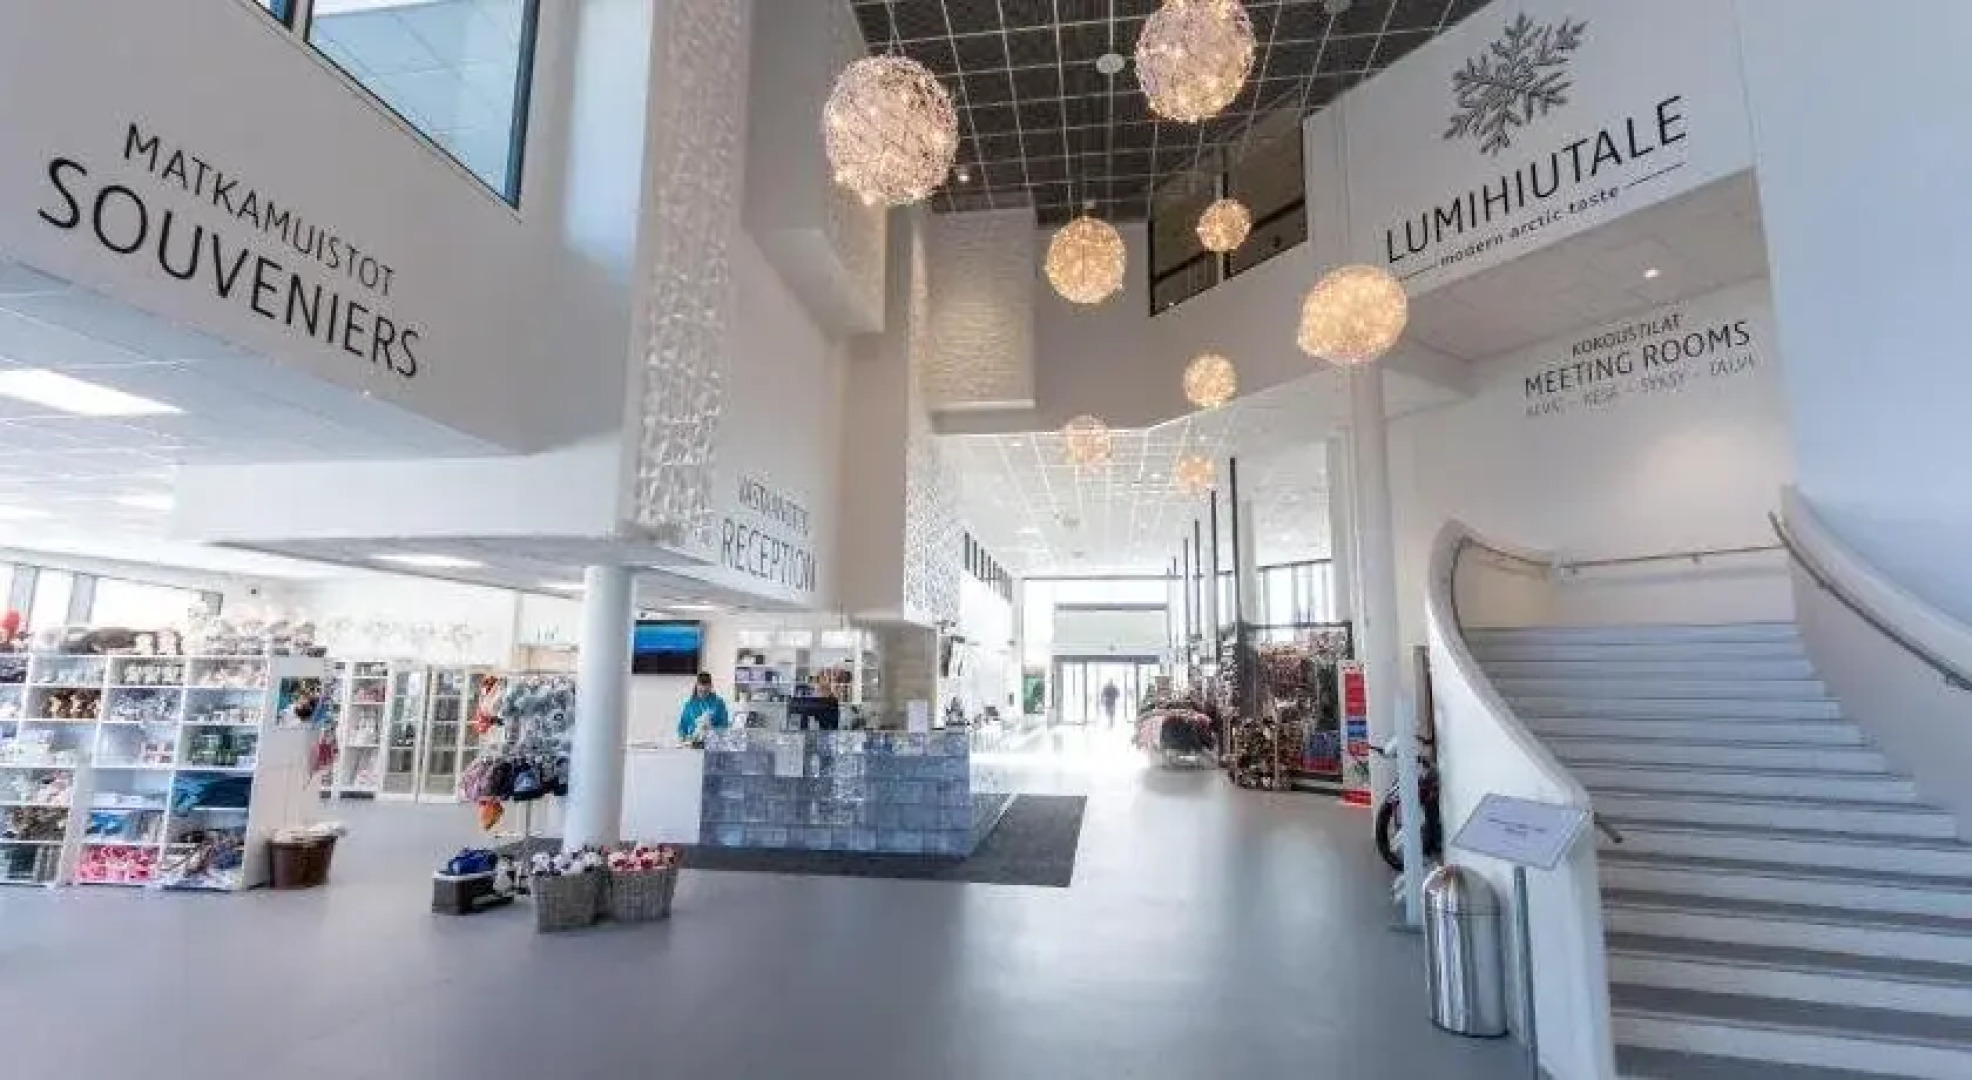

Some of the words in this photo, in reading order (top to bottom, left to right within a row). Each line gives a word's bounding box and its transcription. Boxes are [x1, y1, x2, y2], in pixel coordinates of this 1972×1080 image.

[123, 120, 395, 297] MATKAMUISTOT
[1386, 94, 1688, 264] LUMIHIUTALE
[1440, 233, 1504, 267] modern
[1509, 208, 1563, 239] arctic
[1568, 185, 1619, 214] taste
[36, 156, 420, 379] SOUVENIERS
[1524, 352, 1633, 398] MEETING
[1642, 320, 1751, 370] ROOMS
[1572, 313, 1684, 358] KOKOUSTILAT
[720, 517, 816, 593] RECEPTION
